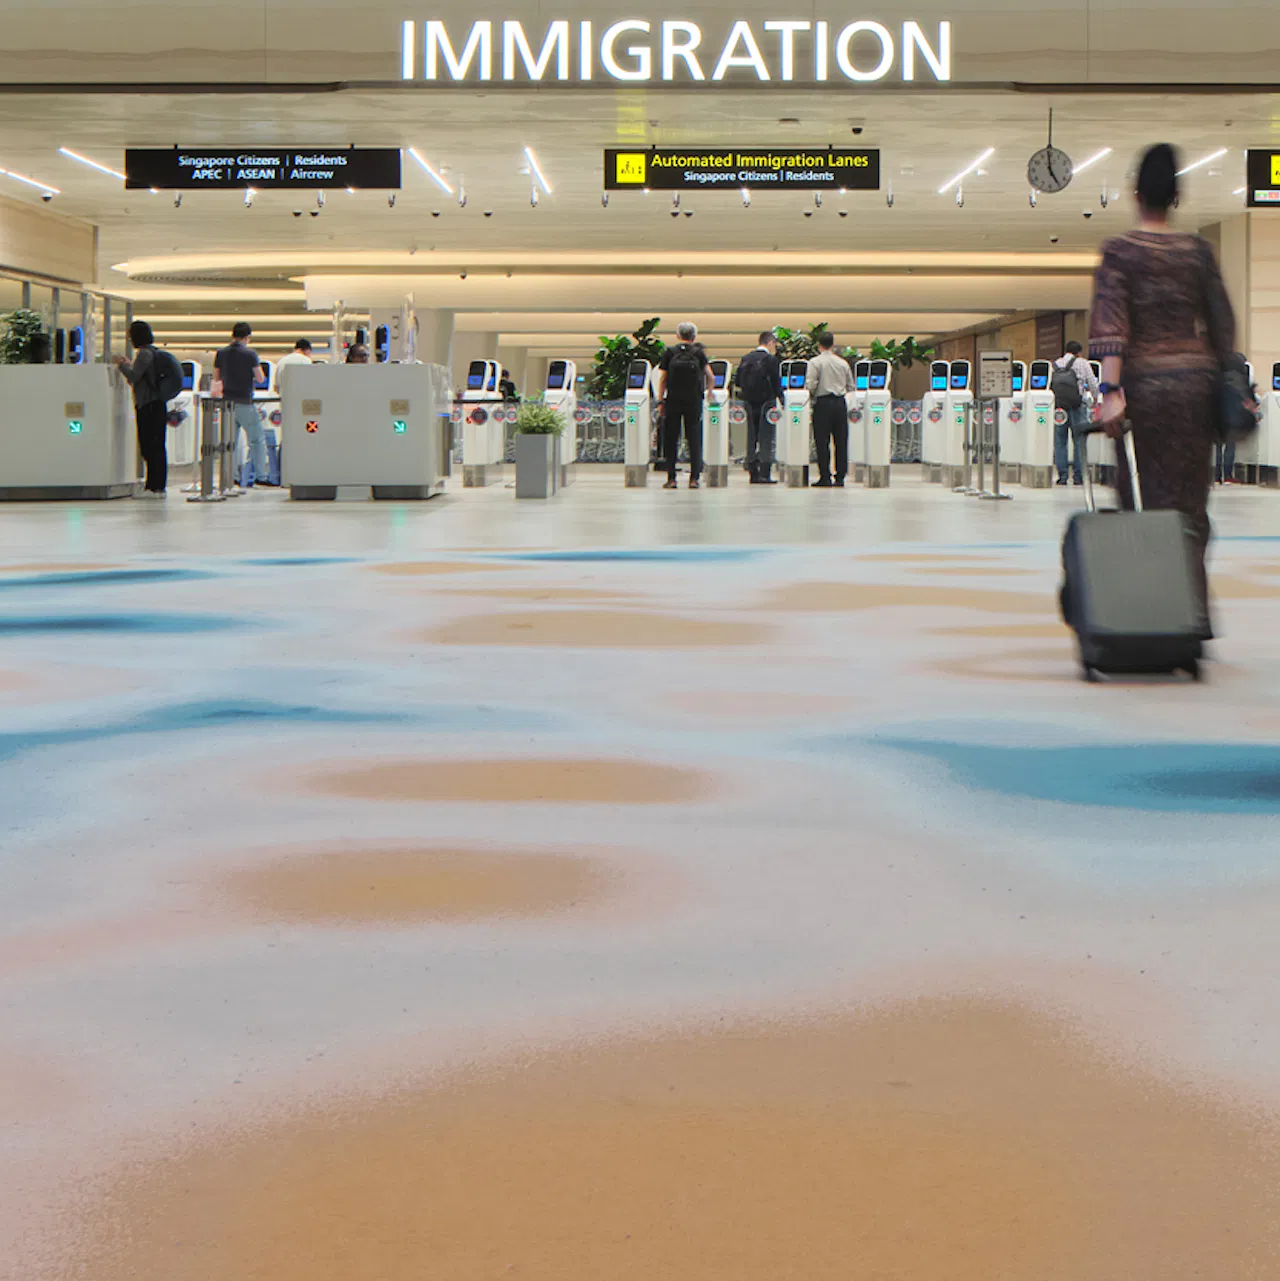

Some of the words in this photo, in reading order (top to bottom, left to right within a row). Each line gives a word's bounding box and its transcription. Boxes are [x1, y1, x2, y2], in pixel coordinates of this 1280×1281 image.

[402, 19, 952, 81] IMMIGRATION
[178, 155, 234, 167] Singapore
[236, 155, 280, 166] Citizens
[294, 155, 347, 166] Residents
[651, 153, 734, 167] Automated
[736, 153, 824, 170] Immigration
[828, 153, 869, 167] Lanes
[192, 169, 222, 180] APEC
[236, 169, 275, 180] ASEAN
[290, 169, 334, 180] Aircrew
[684, 171, 736, 183] Singapore
[738, 171, 778, 181] Citizens
[785, 171, 834, 181] Residents
